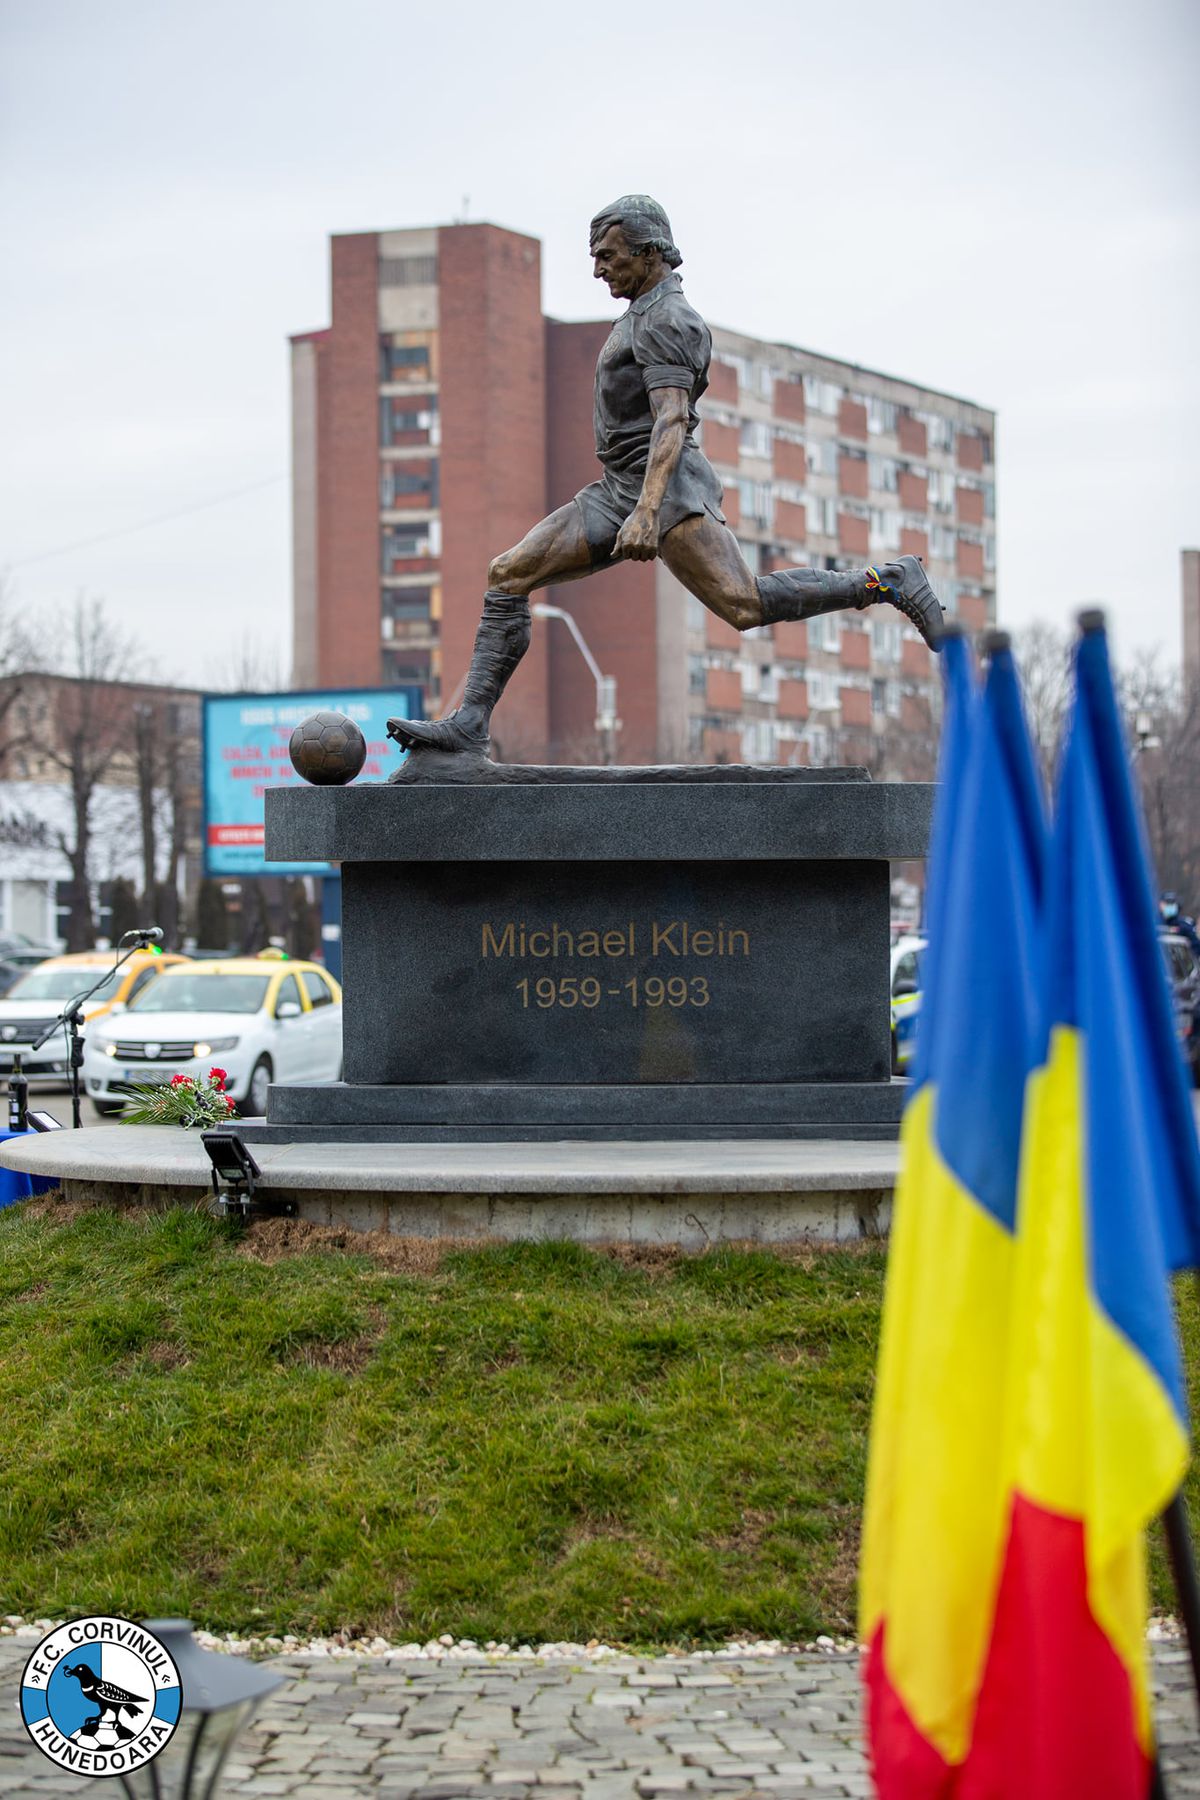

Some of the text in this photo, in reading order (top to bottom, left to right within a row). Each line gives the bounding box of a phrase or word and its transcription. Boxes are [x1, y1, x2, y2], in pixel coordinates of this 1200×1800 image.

[481, 921, 751, 958] Michael Klein
[515, 976, 711, 1009] 1959-1993
